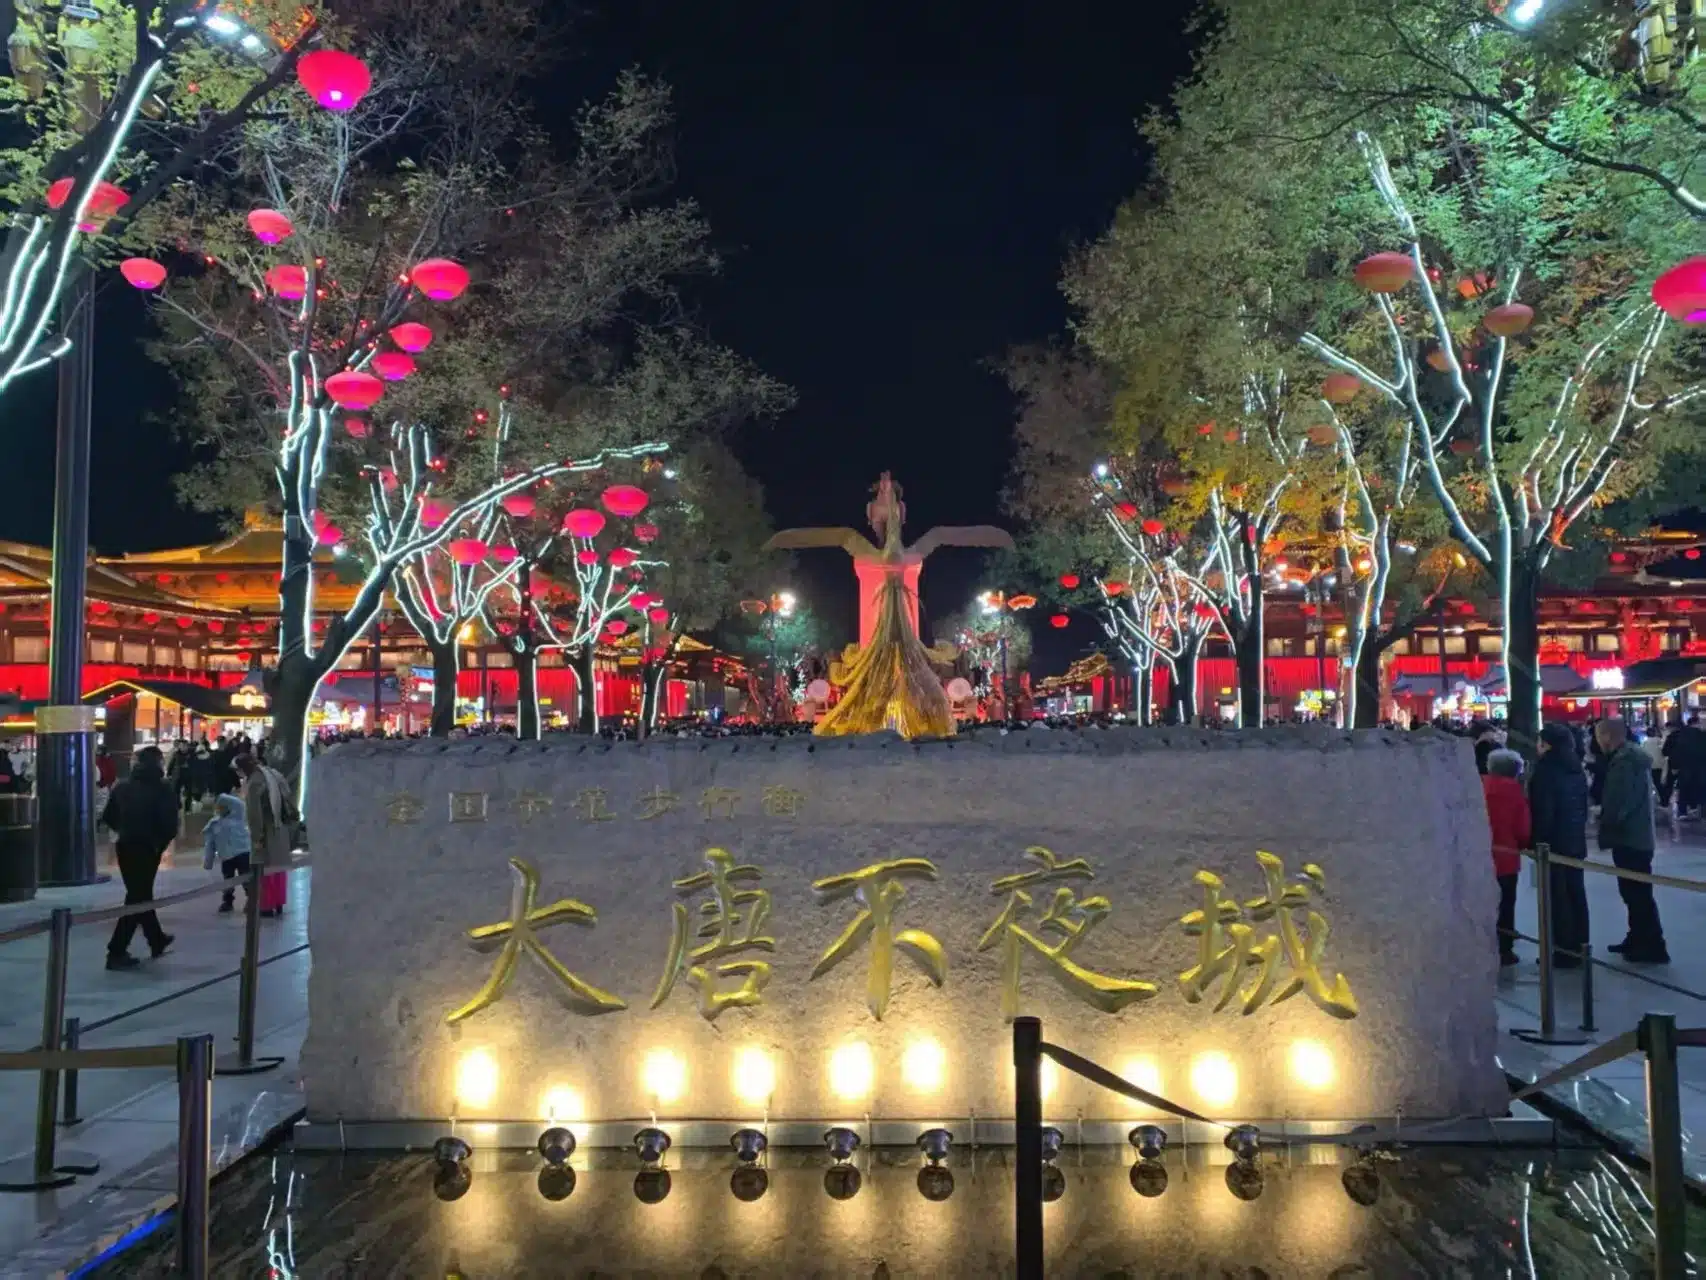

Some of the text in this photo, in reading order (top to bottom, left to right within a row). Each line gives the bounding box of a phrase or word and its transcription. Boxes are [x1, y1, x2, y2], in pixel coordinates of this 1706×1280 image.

[446, 846, 1358, 1024] 大唐不夜城
